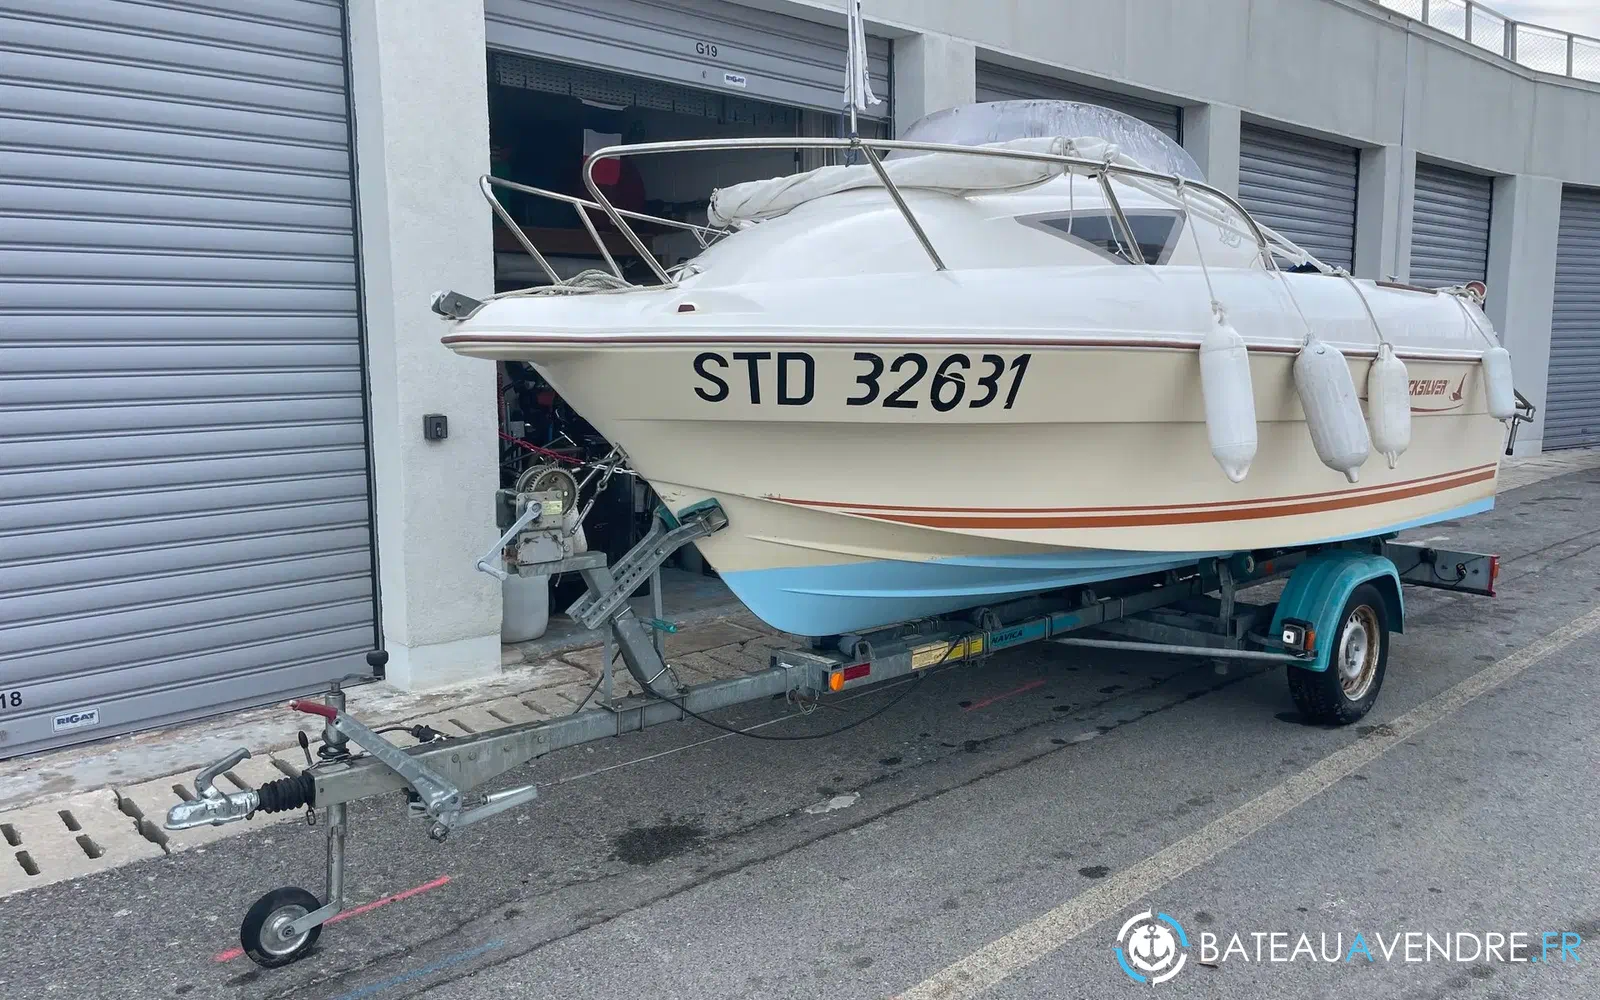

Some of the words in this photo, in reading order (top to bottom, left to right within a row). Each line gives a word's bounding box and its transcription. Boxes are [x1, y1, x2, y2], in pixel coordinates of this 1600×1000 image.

[695, 42, 718, 58] G19
[693, 352, 816, 406] STD
[846, 352, 1032, 412] 32631
[991, 629, 1023, 645] NAVICA
